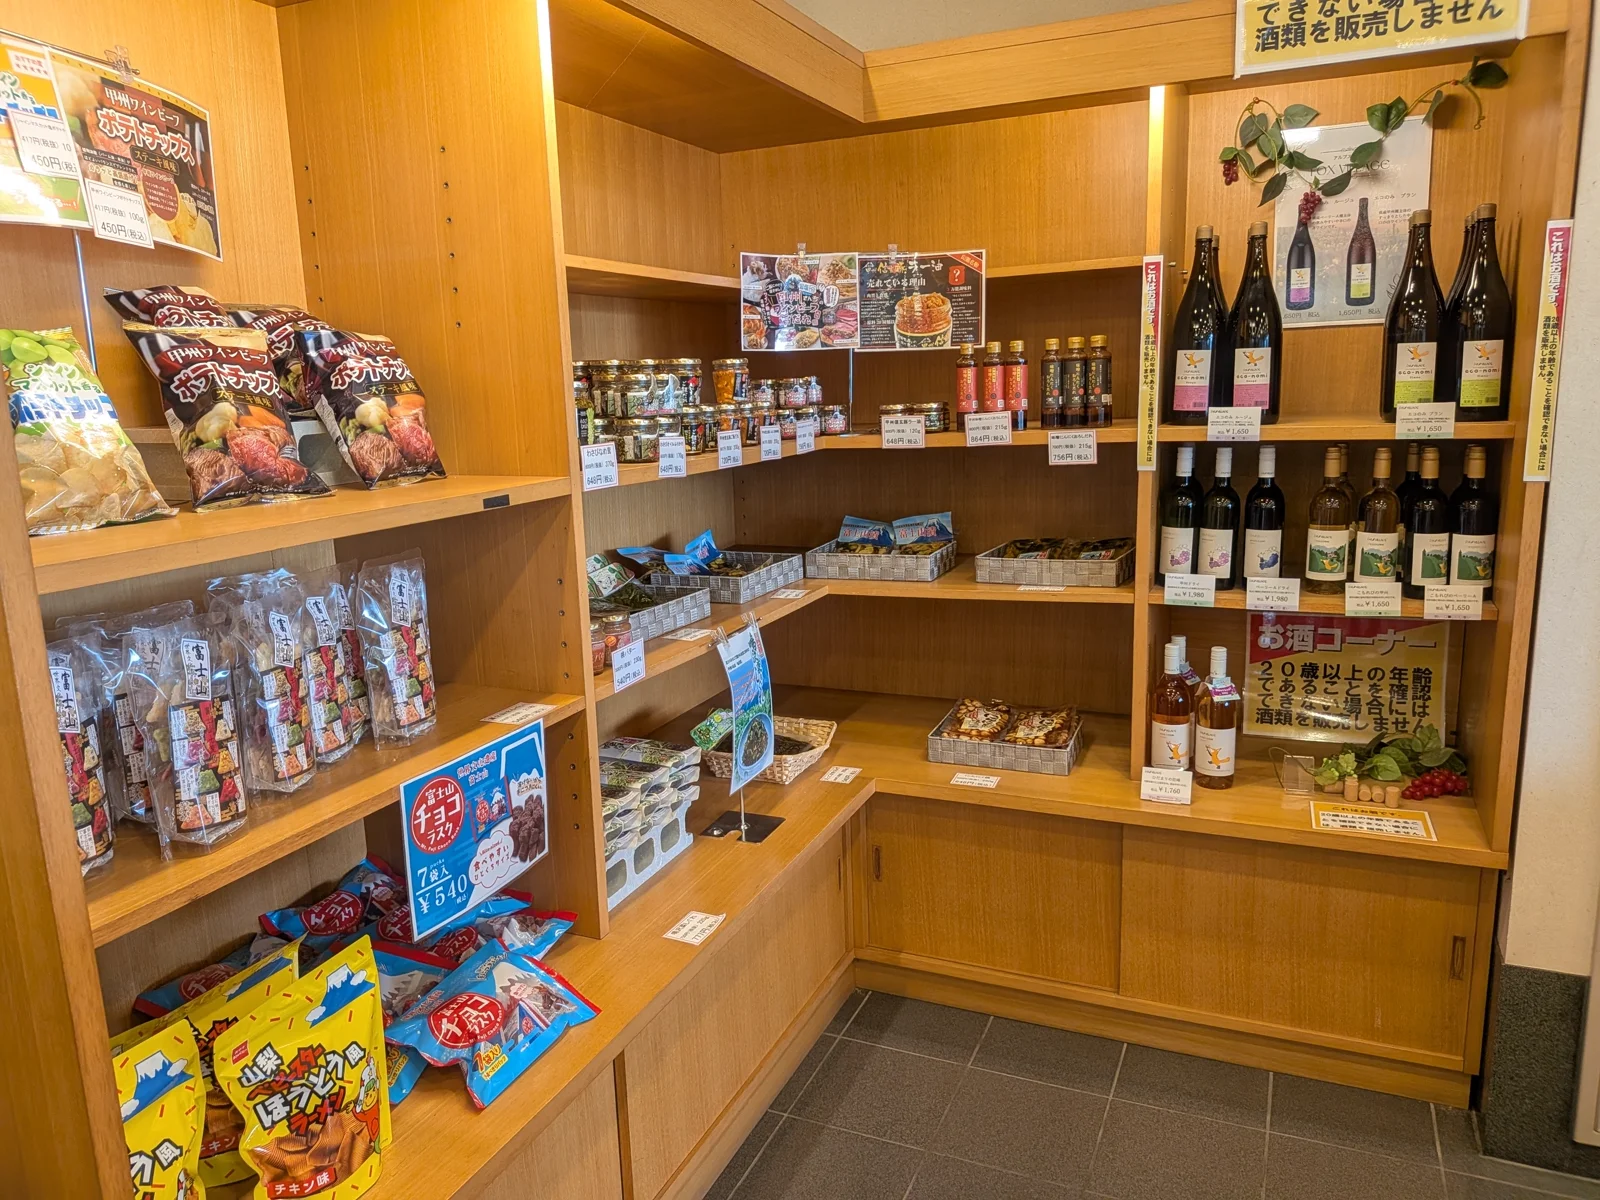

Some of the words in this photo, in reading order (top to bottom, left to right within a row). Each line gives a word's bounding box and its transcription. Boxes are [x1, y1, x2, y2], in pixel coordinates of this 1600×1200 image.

[1255, 1, 1504, 52] 酒類を販売しません
[104, 86, 180, 128] 甲州ワインビーフ
[96, 108, 196, 167] ポテトチップス
[134, 148, 178, 173] ステーキ風味
[101, 221, 148, 242] 450円(税込)
[1547, 231, 1564, 307] これはお酒です。
[167, 347, 269, 365] 甲州ワインビーフ
[886, 437, 921, 445] 648円(税込)
[970, 435, 1008, 443] 864円(税込)
[1052, 453, 1092, 461] 756円(税込)
[277, 617, 292, 663] 富士山
[1257, 624, 1438, 656] お酒コーナー
[192, 643, 208, 697] 富士山
[61, 670, 77, 729] 富士山
[1257, 677, 1432, 701] であることを確認
[1257, 692, 1430, 720] できない場合には
[425, 783, 454, 806] 富士山
[1158, 786, 1181, 794] ¥1,760
[413, 793, 460, 834] チョコ
[427, 822, 453, 845] ラスク
[417, 874, 467, 915] ¥540
[239, 1043, 281, 1087] 山梨
[247, 1044, 325, 1101] ベビースター
[288, 1087, 345, 1136] ラーメン
[275, 1171, 330, 1194] チキン味
